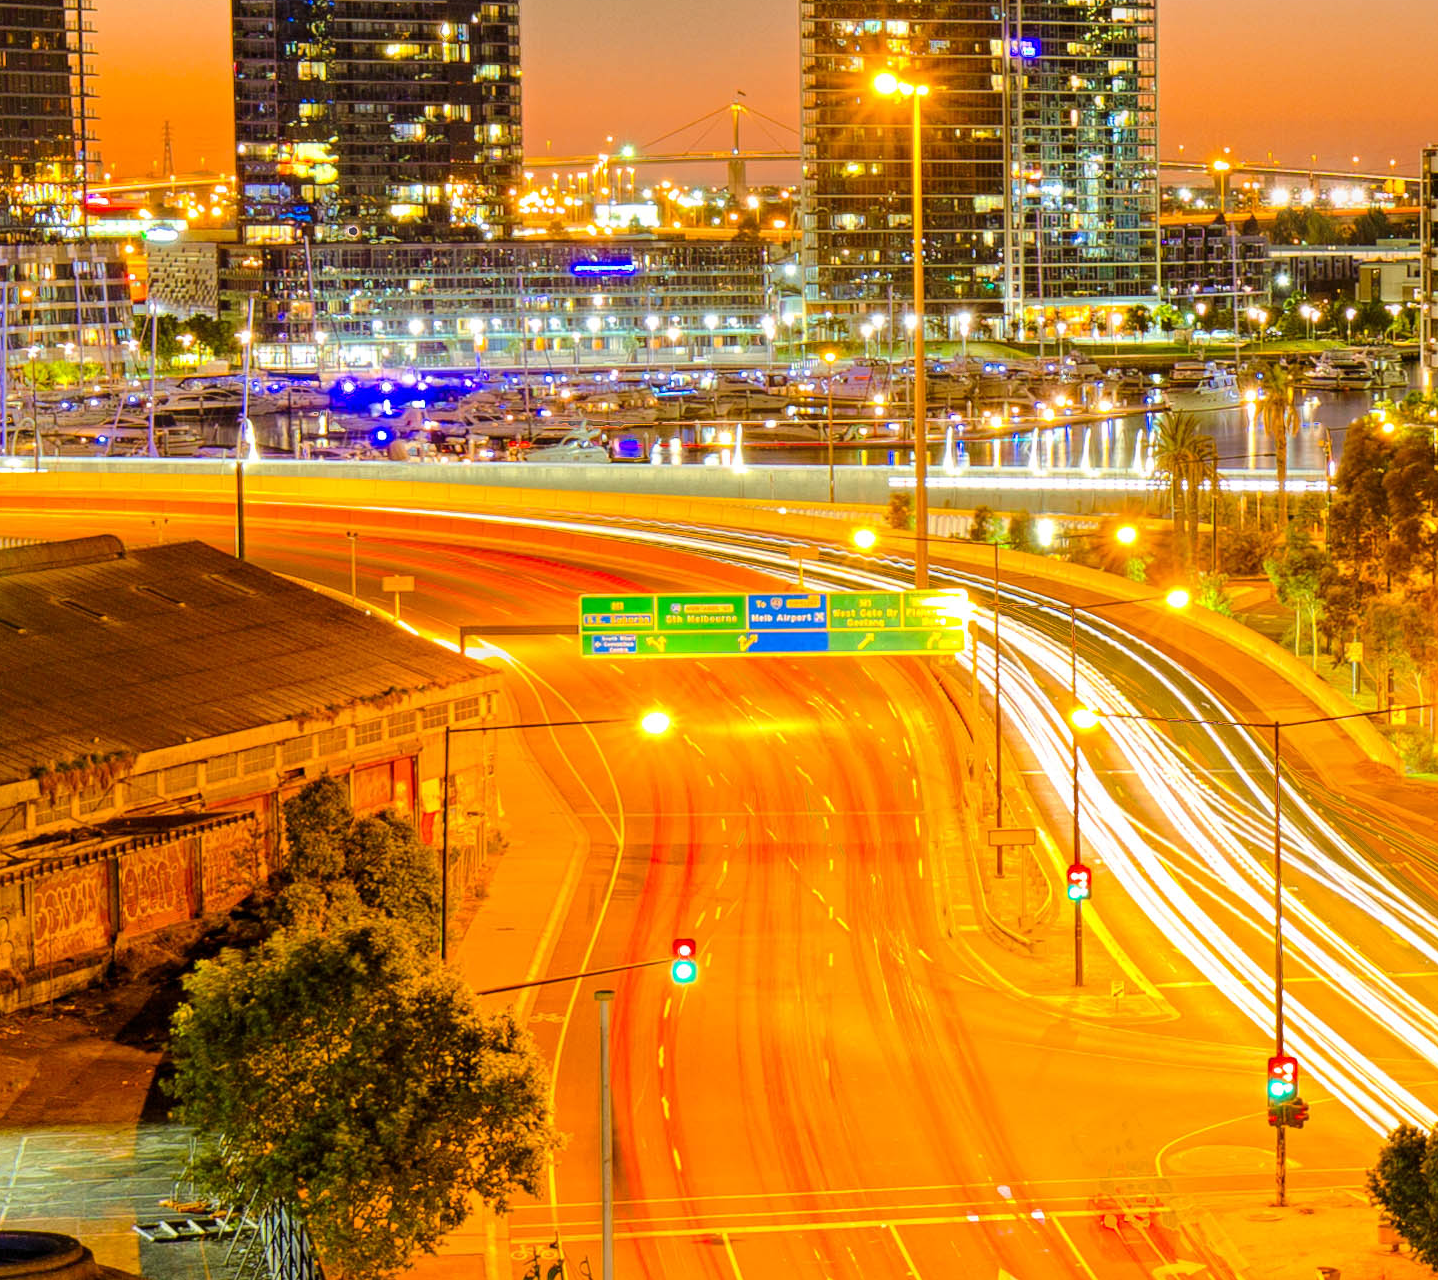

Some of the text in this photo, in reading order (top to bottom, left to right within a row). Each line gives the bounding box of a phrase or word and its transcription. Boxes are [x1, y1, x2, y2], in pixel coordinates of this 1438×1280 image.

[755, 600, 767, 608] To
[751, 613, 812, 623] Melb Airport
[832, 609, 856, 618] West
[859, 609, 882, 618] Gate
[686, 614, 738, 624] Melbourne
